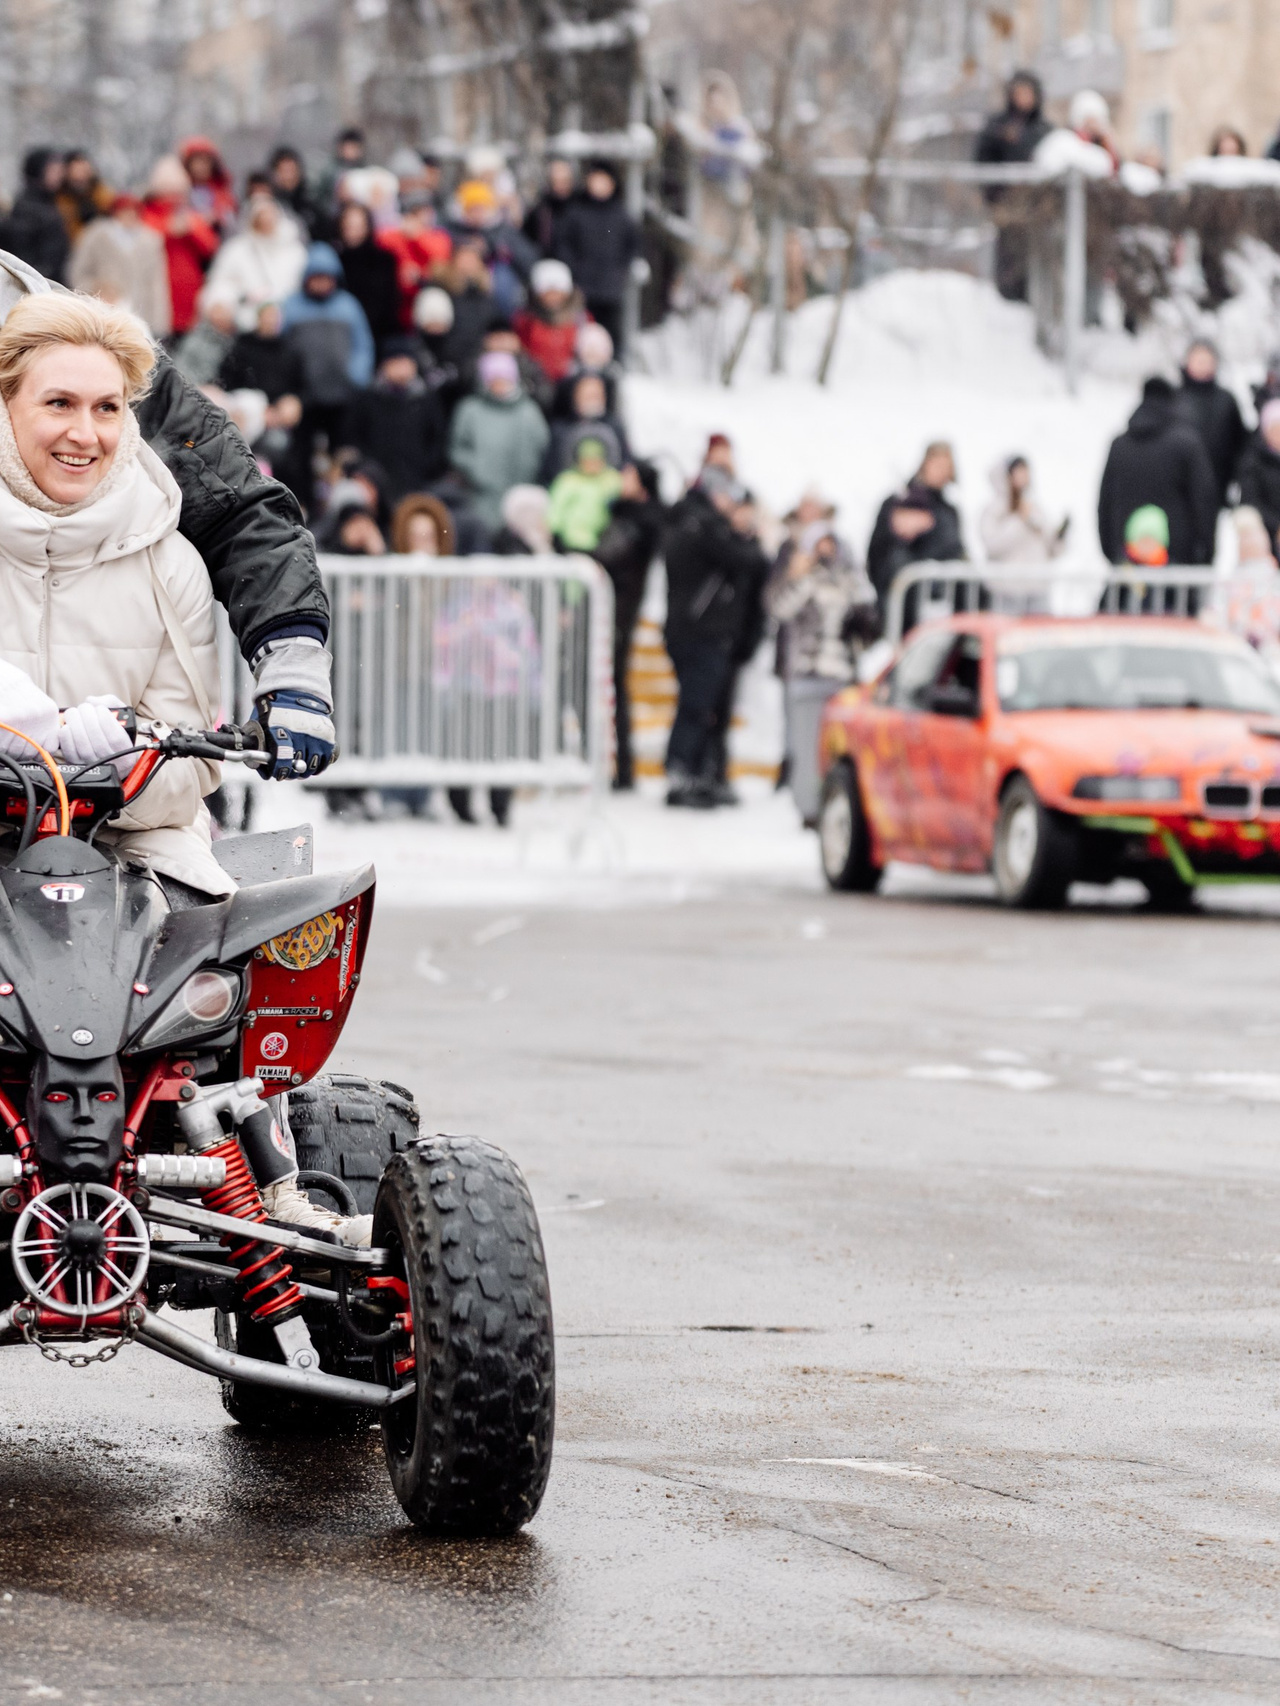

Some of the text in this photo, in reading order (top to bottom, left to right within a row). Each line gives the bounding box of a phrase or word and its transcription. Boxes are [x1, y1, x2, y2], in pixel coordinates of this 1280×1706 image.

[52, 888, 75, 900] 11
[343, 942, 352, 963] Your
[258, 1068, 288, 1076] YAMAHA
